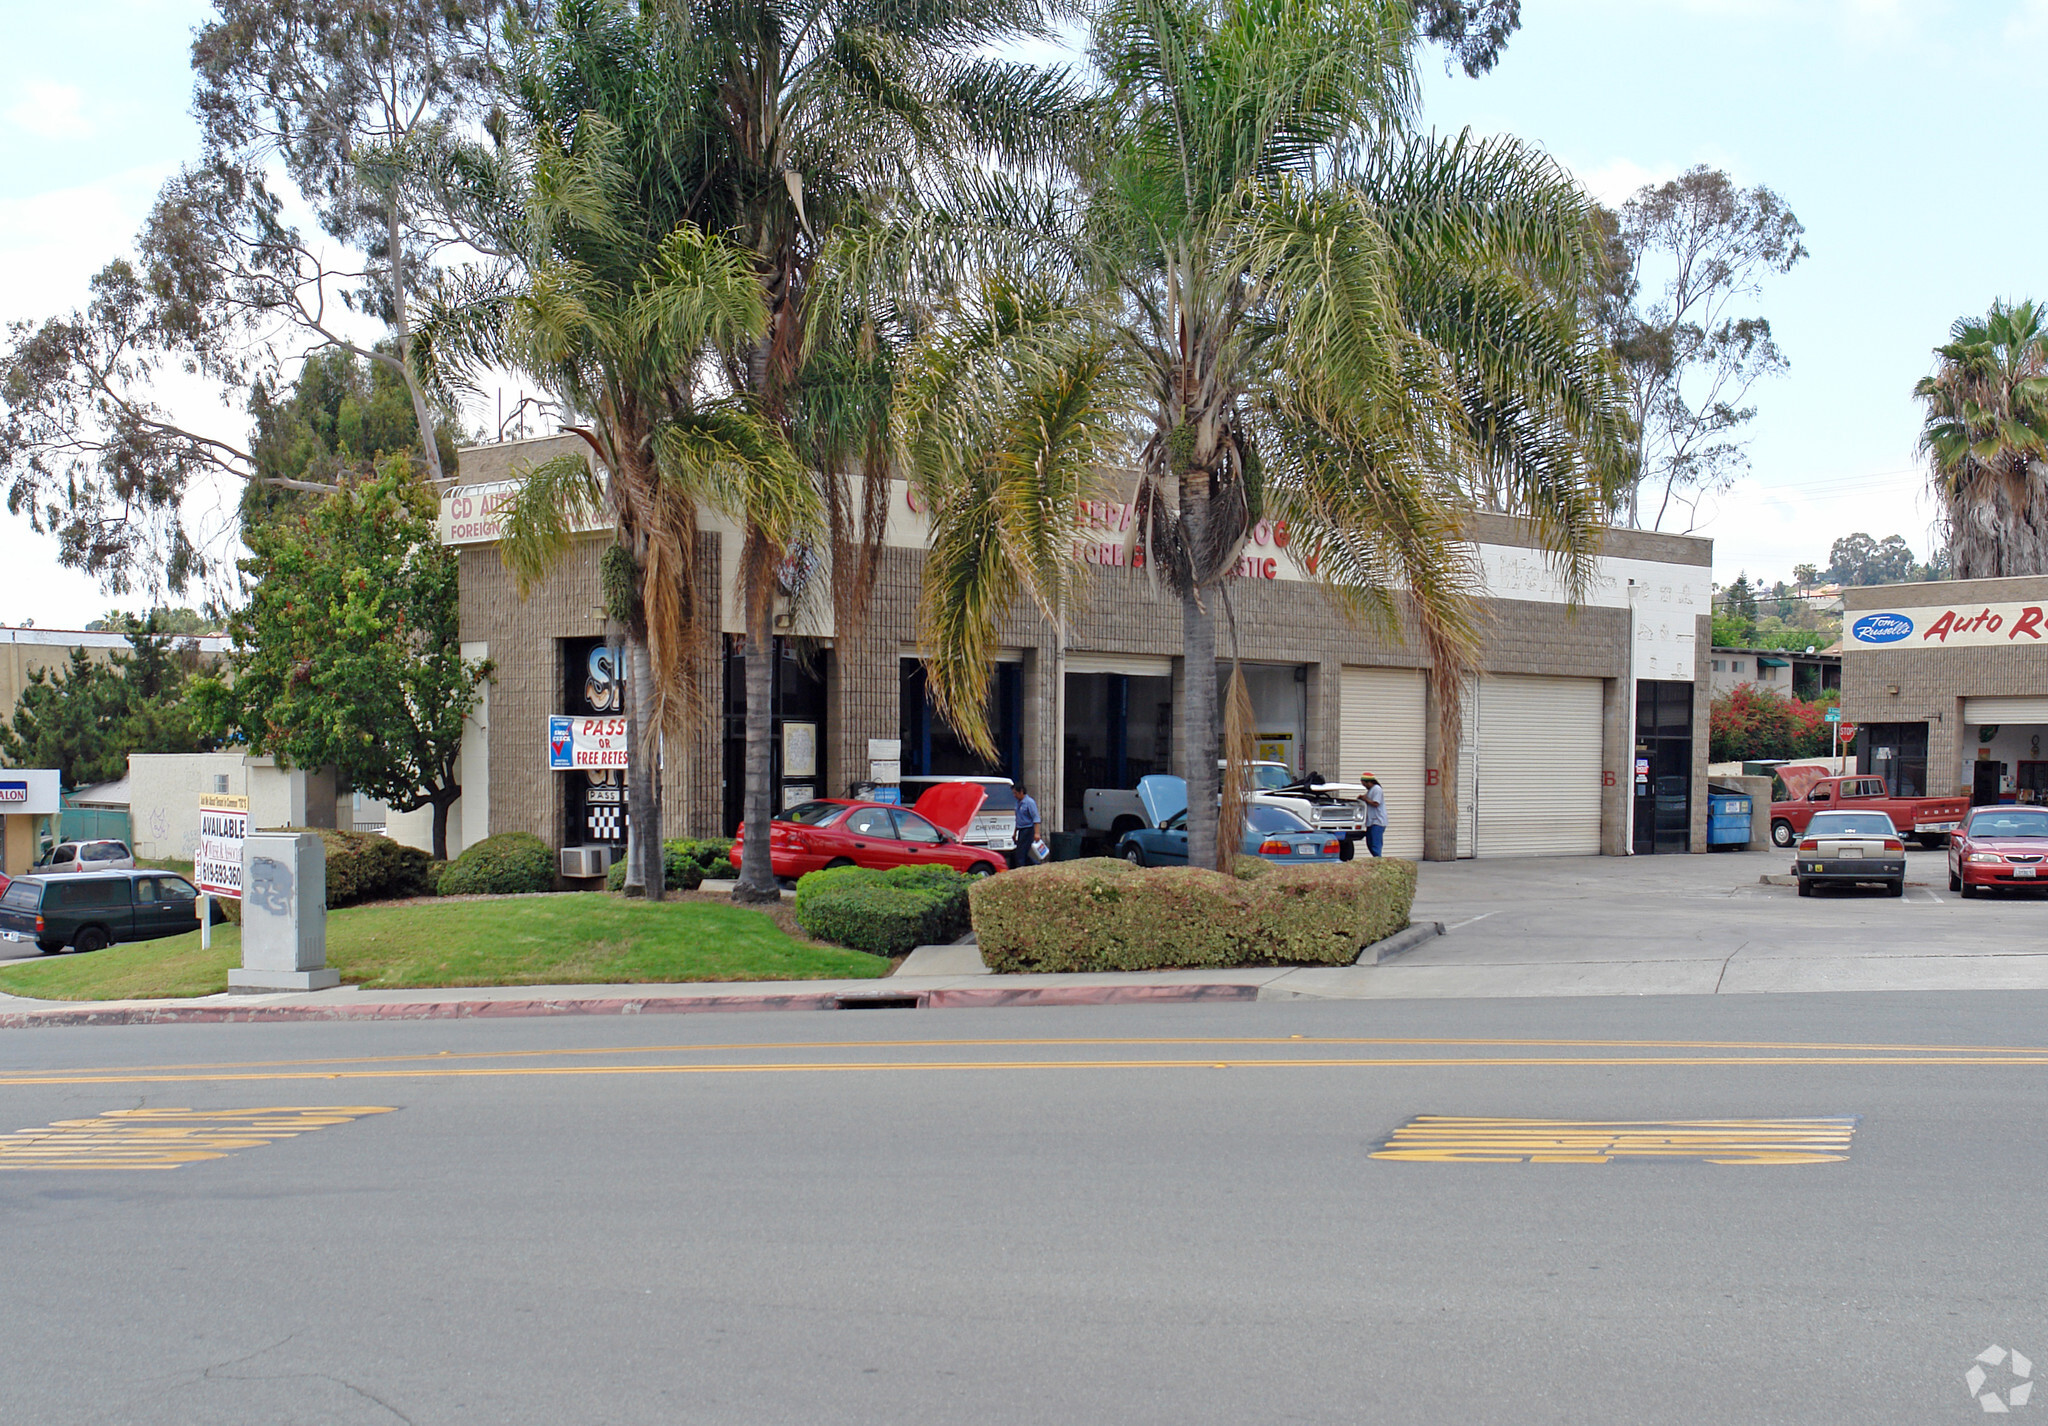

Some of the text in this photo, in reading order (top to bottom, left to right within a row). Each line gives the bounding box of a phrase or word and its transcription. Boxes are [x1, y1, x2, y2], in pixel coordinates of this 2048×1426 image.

[451, 497, 473, 520] CD
[451, 521, 501, 540] FOREIGN
[1868, 616, 1898, 628] Tom
[1923, 606, 2048, 643] Auto R
[1857, 621, 1910, 640] Russell's
[583, 719, 626, 736] PASS
[1840, 727, 1854, 736] STOP
[598, 738, 611, 749] OR
[576, 751, 599, 765] FREE
[590, 791, 615, 800] PASS
[202, 816, 246, 839] AVAILABLE
[975, 824, 1011, 832] CHEVROLET
